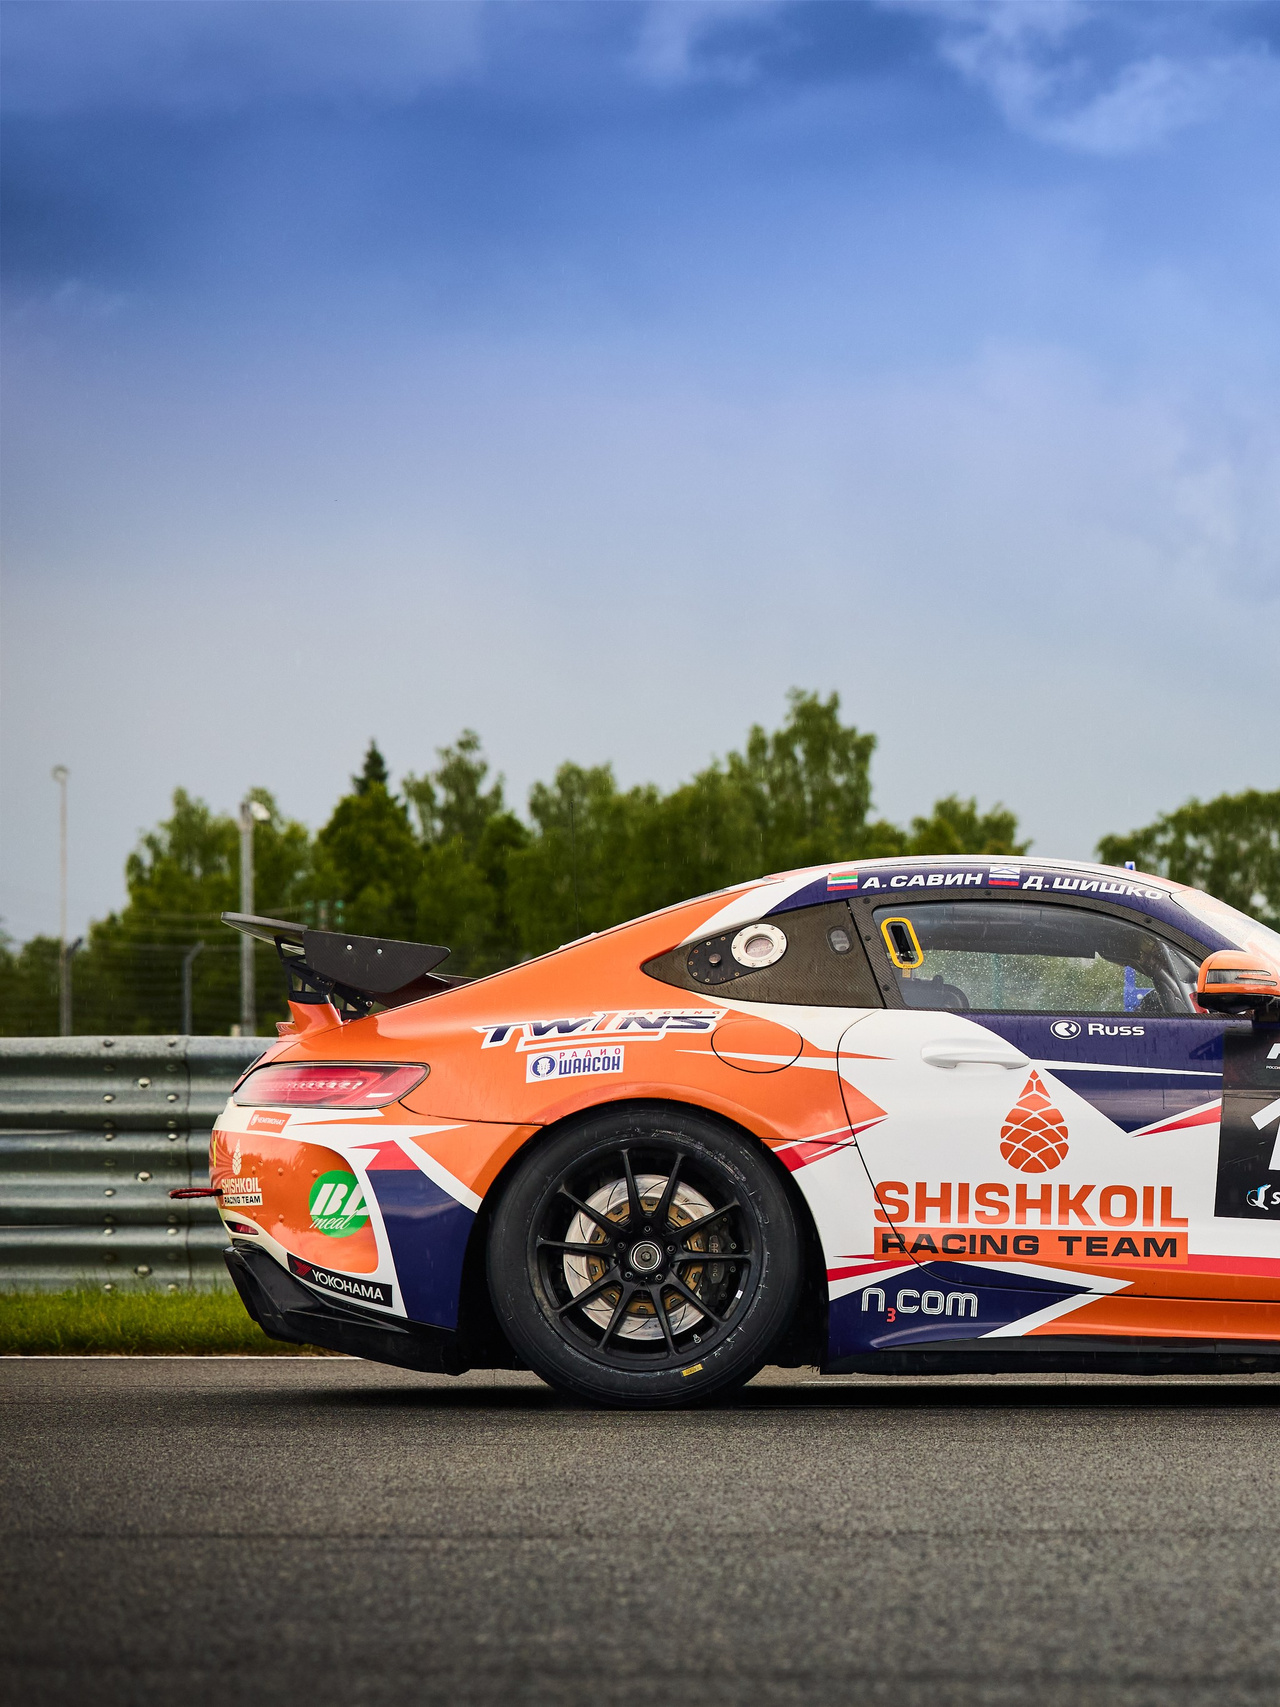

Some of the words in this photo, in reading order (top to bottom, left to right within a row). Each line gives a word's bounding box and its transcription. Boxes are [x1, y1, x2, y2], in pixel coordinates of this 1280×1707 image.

[861, 873, 984, 890] А.САВИН
[1021, 875, 1164, 901] Д.ШИШКО
[482, 1013, 717, 1044] TWINS
[1088, 1023, 1145, 1037] Russ
[559, 1048, 621, 1059] РАДИО
[559, 1056, 621, 1076] ШАНСОН
[222, 1177, 262, 1194] SHISHKOIL
[242, 1195, 261, 1204] TEAM
[874, 1181, 1188, 1228] SHISHKOIL
[309, 1211, 354, 1230] meal
[881, 1233, 1040, 1256] RACING
[1058, 1235, 1177, 1258] TEAM
[312, 1269, 384, 1301] YOKOHAMA
